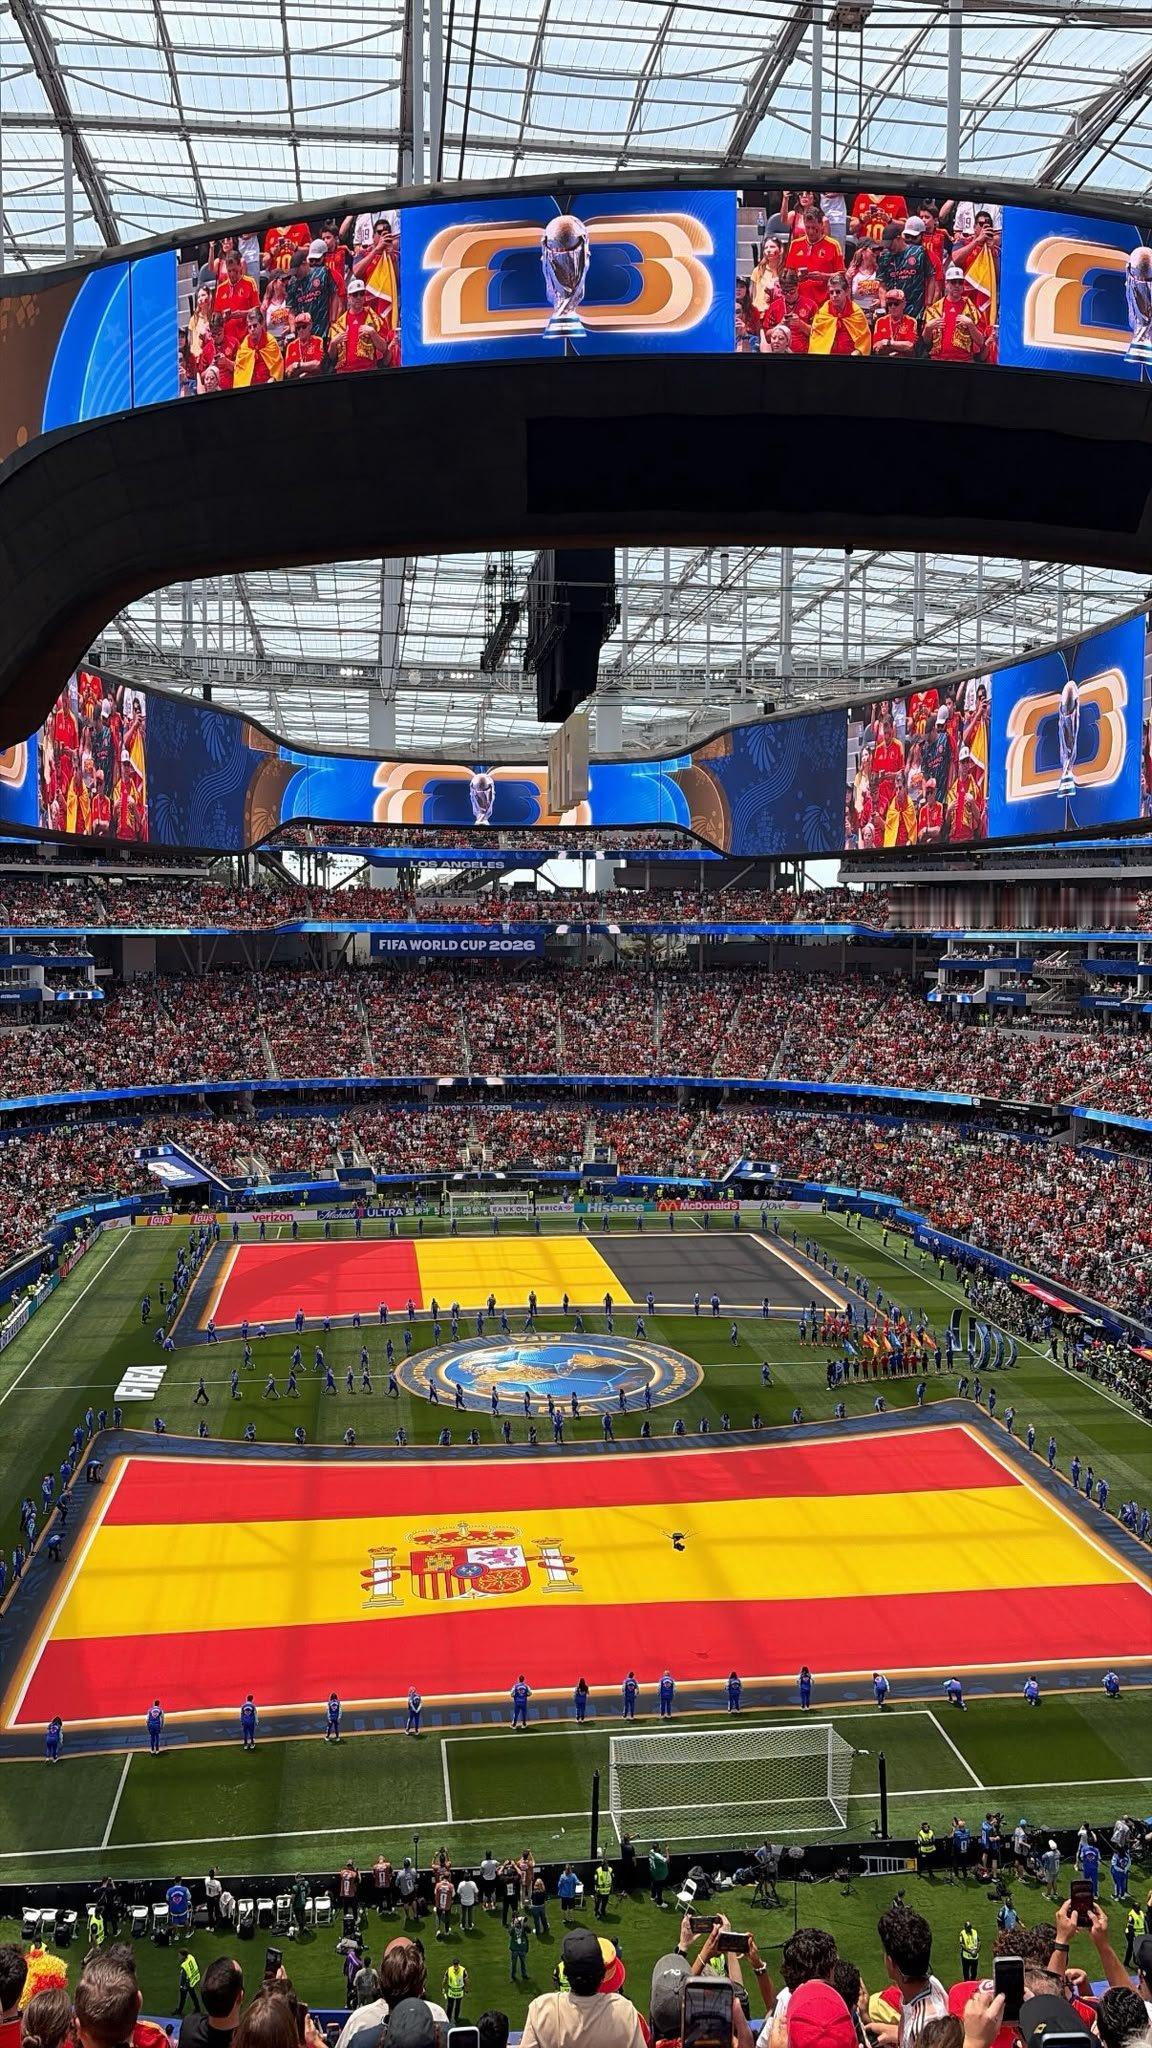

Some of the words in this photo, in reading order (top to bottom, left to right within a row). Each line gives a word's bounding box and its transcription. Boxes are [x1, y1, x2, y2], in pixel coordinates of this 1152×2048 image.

[410, 860, 438, 868] LOS
[441, 861, 505, 869] ANGELES
[379, 939, 407, 950] FIFA
[409, 940, 457, 950] WORLD
[460, 940, 487, 951] CUP
[489, 940, 536, 951] 2026
[587, 1203, 644, 1212] Hisense
[679, 1201, 738, 1211] McDonald's
[252, 1213, 294, 1222] verizon
[319, 1209, 356, 1219] Michelob
[367, 1208, 403, 1217] ULTRA
[114, 1365, 167, 1401] FIFA
